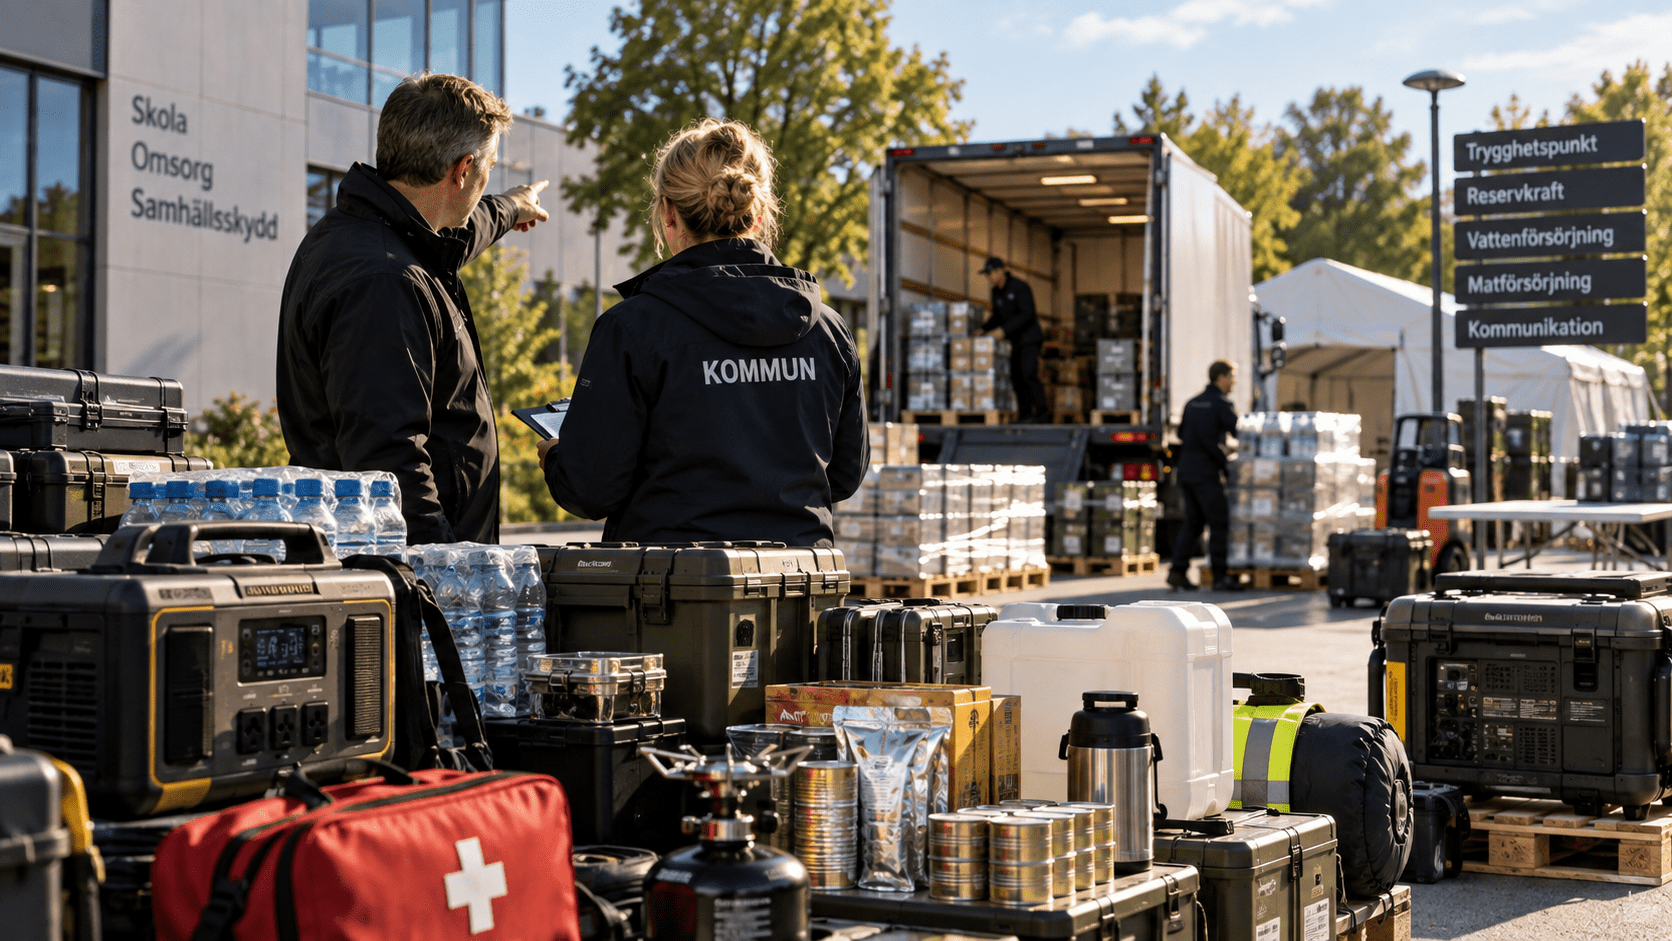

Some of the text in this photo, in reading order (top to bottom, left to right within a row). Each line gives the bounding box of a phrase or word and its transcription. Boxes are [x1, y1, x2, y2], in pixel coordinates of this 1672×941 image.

[131, 95, 188, 135] Skola
[1466, 134, 1598, 163] Trygghetspunkt
[131, 141, 213, 191] Omsorg
[1466, 181, 1565, 205] Reservkraft
[131, 188, 278, 243] Samhällsskydd
[1467, 225, 1614, 249] Vattenförsörjning
[1467, 271, 1592, 295] Matförsörjning
[1468, 316, 1604, 339] Kommunikation
[702, 357, 816, 385] KOMMUN
